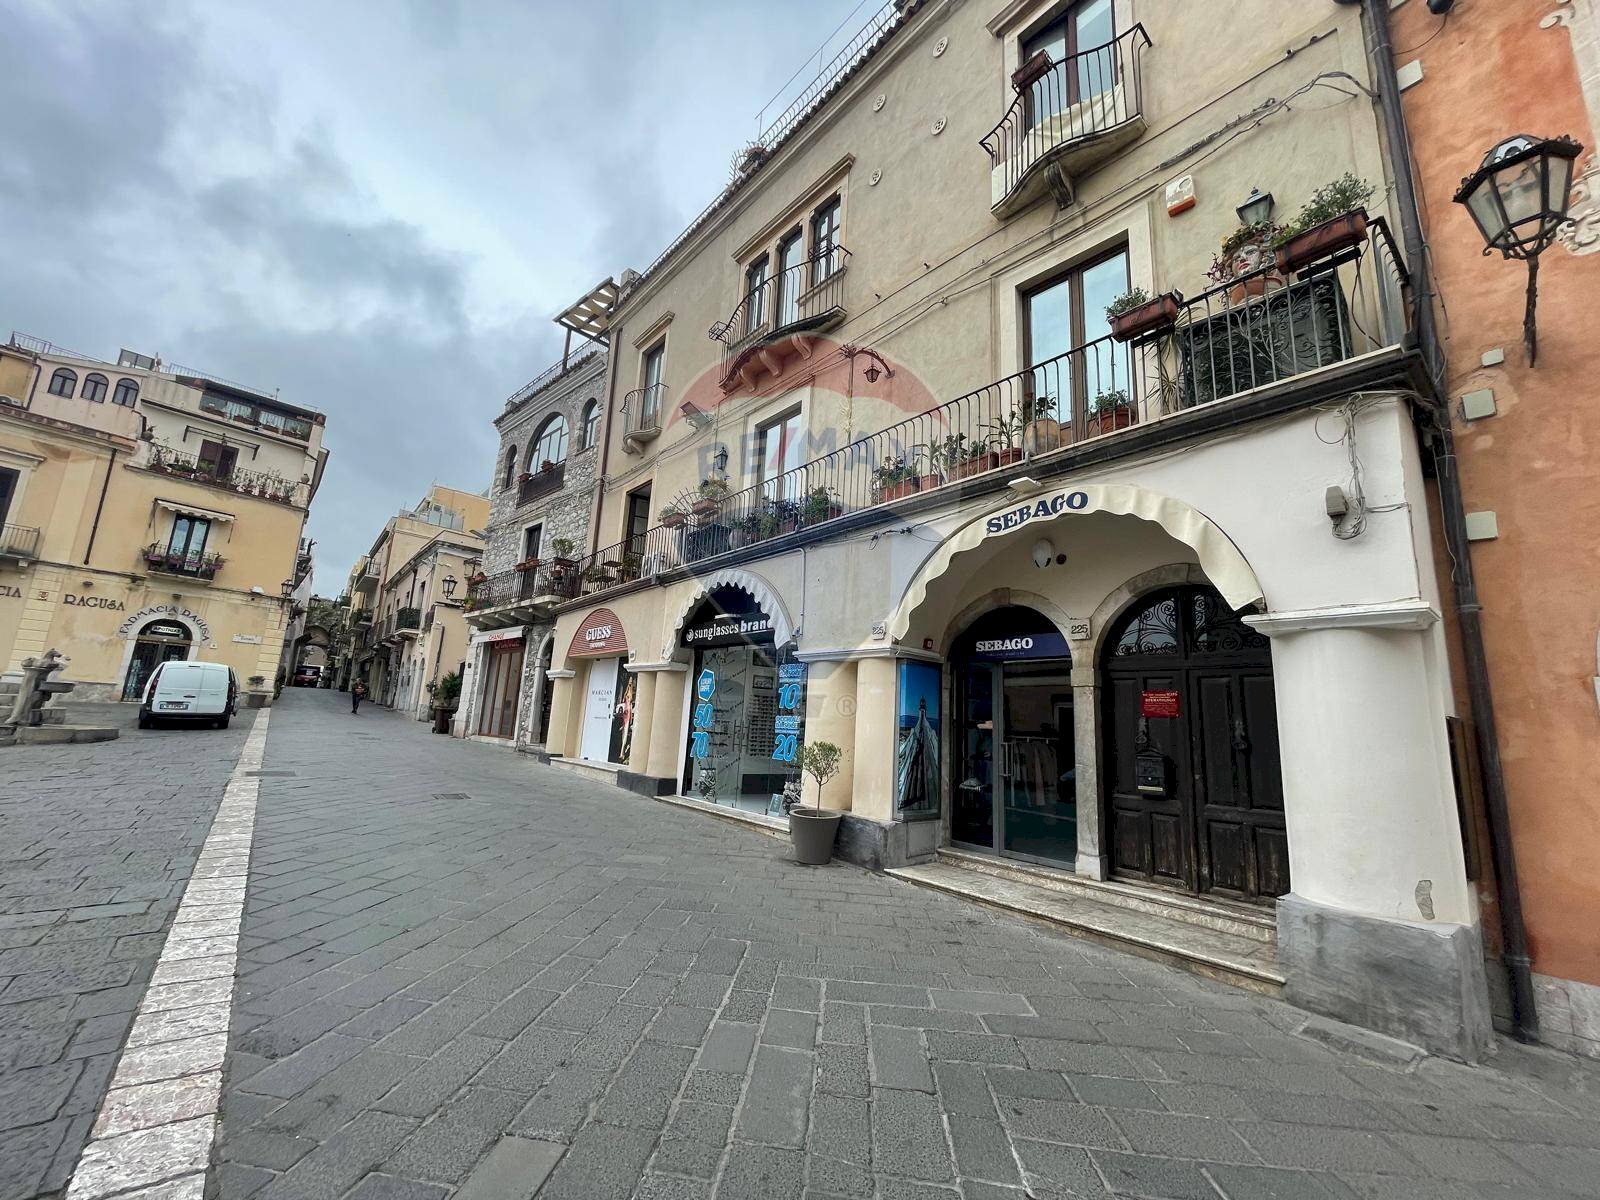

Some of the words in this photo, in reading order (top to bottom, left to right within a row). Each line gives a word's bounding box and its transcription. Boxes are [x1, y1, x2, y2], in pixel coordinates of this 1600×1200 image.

[986, 491, 1089, 536] SEBAGO
[62, 593, 125, 611] RAGUSA
[119, 604, 178, 634] FARMACIA
[586, 625, 612, 641] GUESS
[694, 623, 739, 641] sunglasses
[1071, 624, 1088, 634] 225
[975, 637, 1034, 652] SEBAGO
